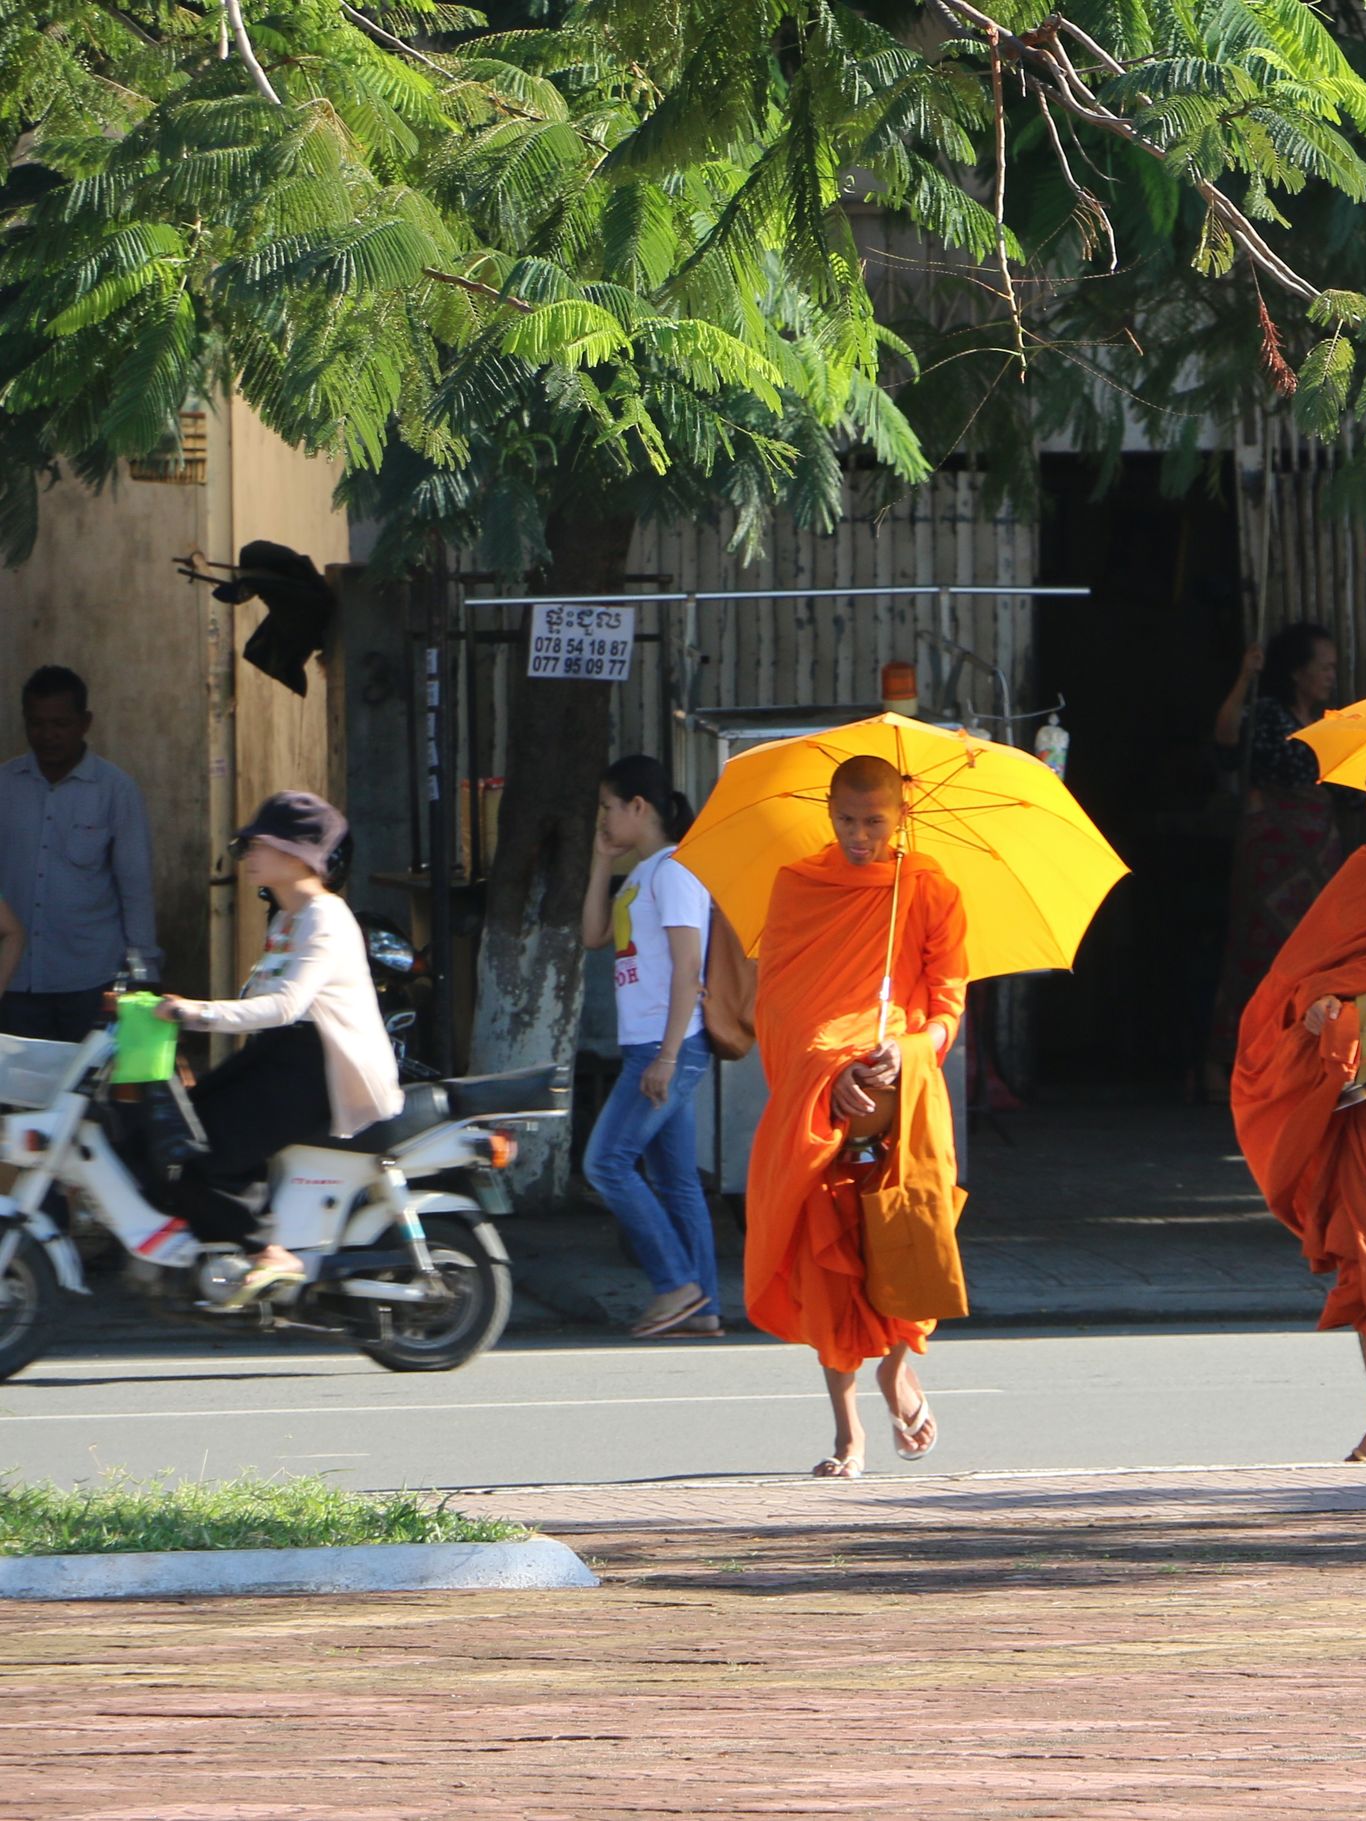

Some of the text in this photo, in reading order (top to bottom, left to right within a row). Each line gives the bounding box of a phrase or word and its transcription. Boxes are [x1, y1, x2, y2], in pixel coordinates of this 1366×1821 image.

[535, 637, 628, 657] 078 54 18 87
[533, 656, 626, 676] 077 95 09 77
